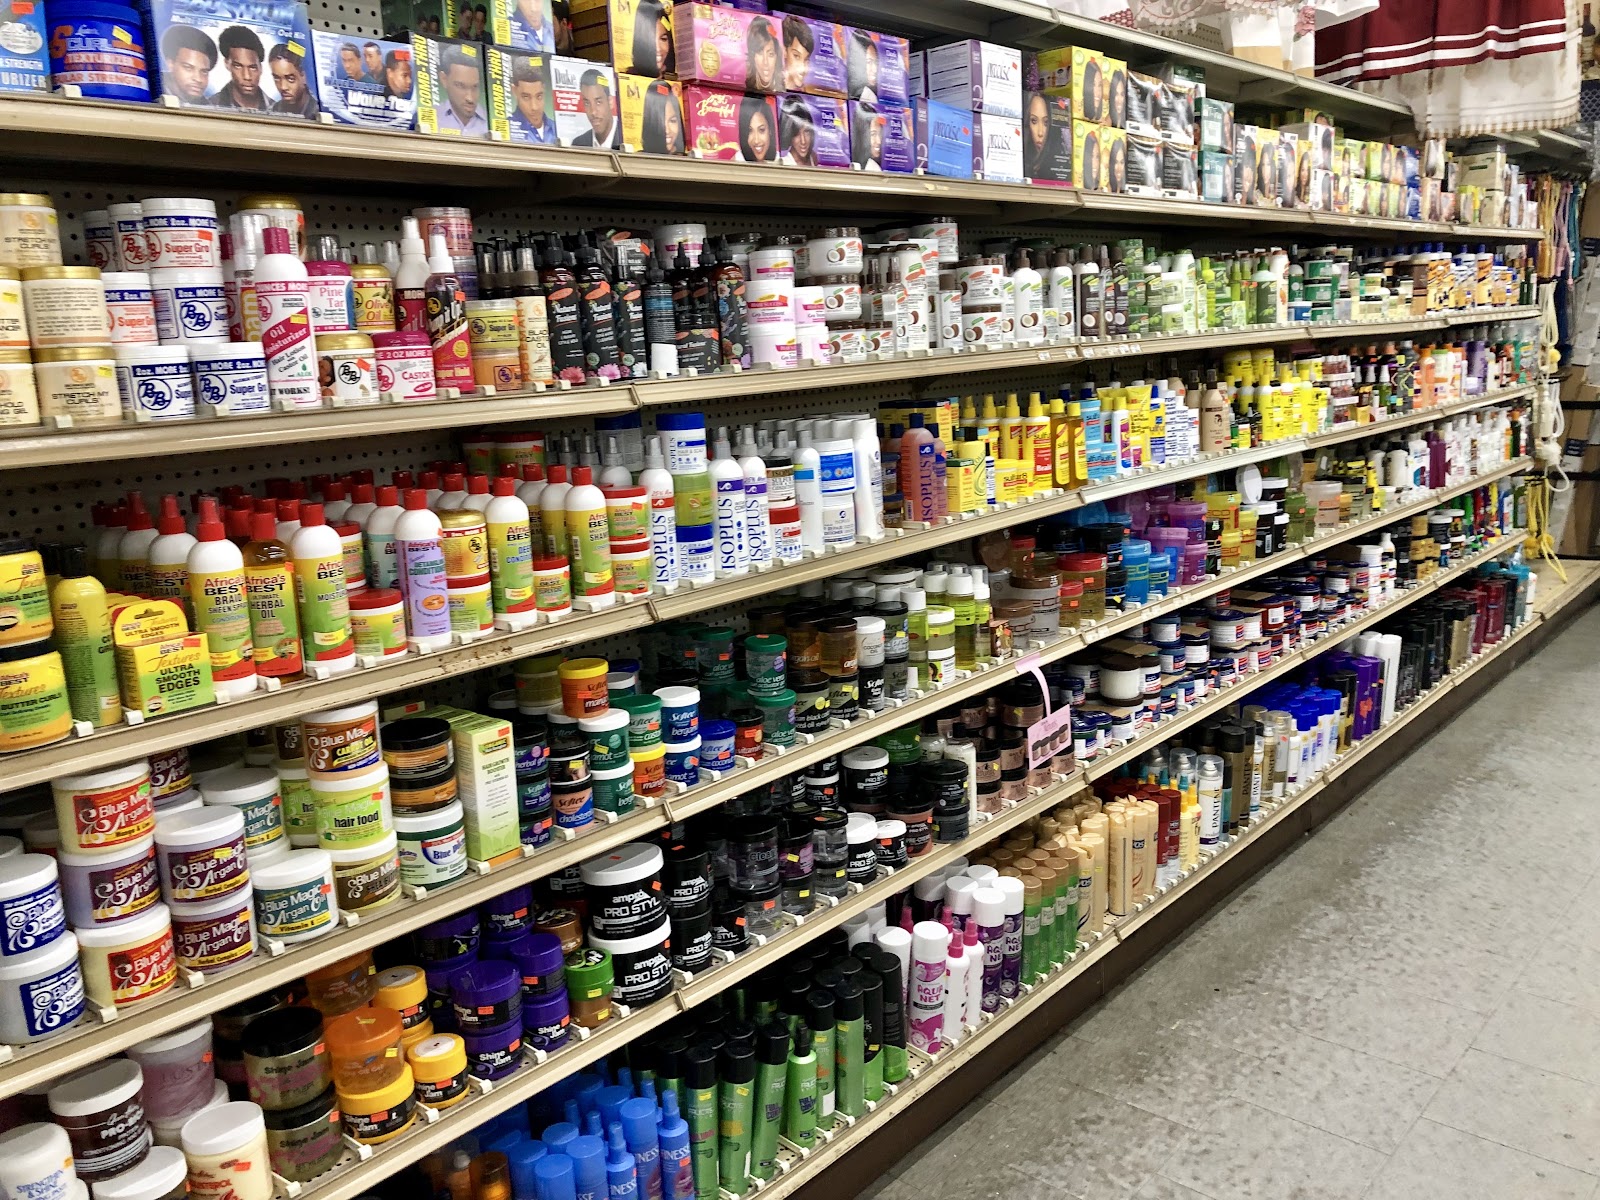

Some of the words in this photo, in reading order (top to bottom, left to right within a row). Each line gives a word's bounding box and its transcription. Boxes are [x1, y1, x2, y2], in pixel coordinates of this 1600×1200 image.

[67, 52, 133, 66] TEXTURIZER
[412, 34, 433, 107] COMB-THRU
[554, 68, 576, 85] Duke
[88, 73, 143, 87] STRENGTH
[491, 49, 506, 119] COMB-THRU
[165, 243, 192, 254] Super
[319, 287, 344, 297] Pine
[327, 298, 345, 308] Tar
[365, 299, 390, 310] Olive
[118, 316, 144, 328] Super
[366, 311, 382, 321] Oil
[269, 324, 286, 339] Oil
[489, 324, 506, 332] Super
[272, 353, 286, 366] Hair
[286, 345, 306, 359] Lotion
[393, 352, 404, 360] OZ
[406, 350, 427, 358] MORE
[211, 362, 234, 370] MORE
[236, 361, 251, 369] 2oz.
[278, 359, 298, 373] Castor
[299, 354, 309, 364] Oil
[136, 367, 154, 376] 2oz.
[155, 366, 177, 375] MORE
[401, 371, 430, 380] CASTOR
[52, 391, 95, 400] STRETCH
[230, 384, 256, 396] Super
[277, 386, 311, 395] WORKS!
[921, 460, 933, 521] ISOPLUS
[721, 497, 736, 570] ISOPLUS
[746, 499, 763, 562] ISOPLUS
[654, 514, 669, 583] ISOPLUS
[246, 583, 285, 593] BEST
[250, 599, 286, 610] HERBAL
[261, 609, 276, 619] OIL
[148, 623, 180, 632] SMOOTH
[160, 663, 194, 675] ULTRA
[155, 669, 201, 684] SMOOTH
[158, 677, 200, 694] EDGES
[1, 699, 38, 710] BUTTER
[320, 731, 344, 747] Blue
[153, 757, 178, 773] Blue
[558, 796, 586, 808] Softee
[99, 801, 128, 818] Blue
[334, 817, 354, 828] hair
[357, 811, 379, 825] food
[433, 850, 451, 859] Blue
[191, 857, 217, 875] Blue
[115, 872, 141, 890] Blue
[355, 868, 379, 882] Blue
[674, 888, 692, 896] PRO
[265, 897, 289, 913] Blue
[273, 904, 311, 927] Argan
[604, 907, 631, 918] PRO
[279, 923, 309, 933] Vitamin
[502, 918, 520, 927] Jam
[184, 931, 211, 946] Blue
[192, 935, 233, 959] Argan
[686, 945, 703, 954] PRO
[133, 952, 159, 971] Blue
[624, 972, 650, 985] PRO
[917, 985, 943, 995] AQUA
[920, 994, 940, 1003] NET
[462, 1012, 478, 1023] Jam
[538, 1024, 561, 1034] Shine
[550, 1027, 565, 1039] Jam
[479, 1050, 506, 1062] Shine
[492, 1054, 511, 1066] Jam
[424, 1090, 443, 1098] Jam
[356, 1123, 380, 1132] Jam
